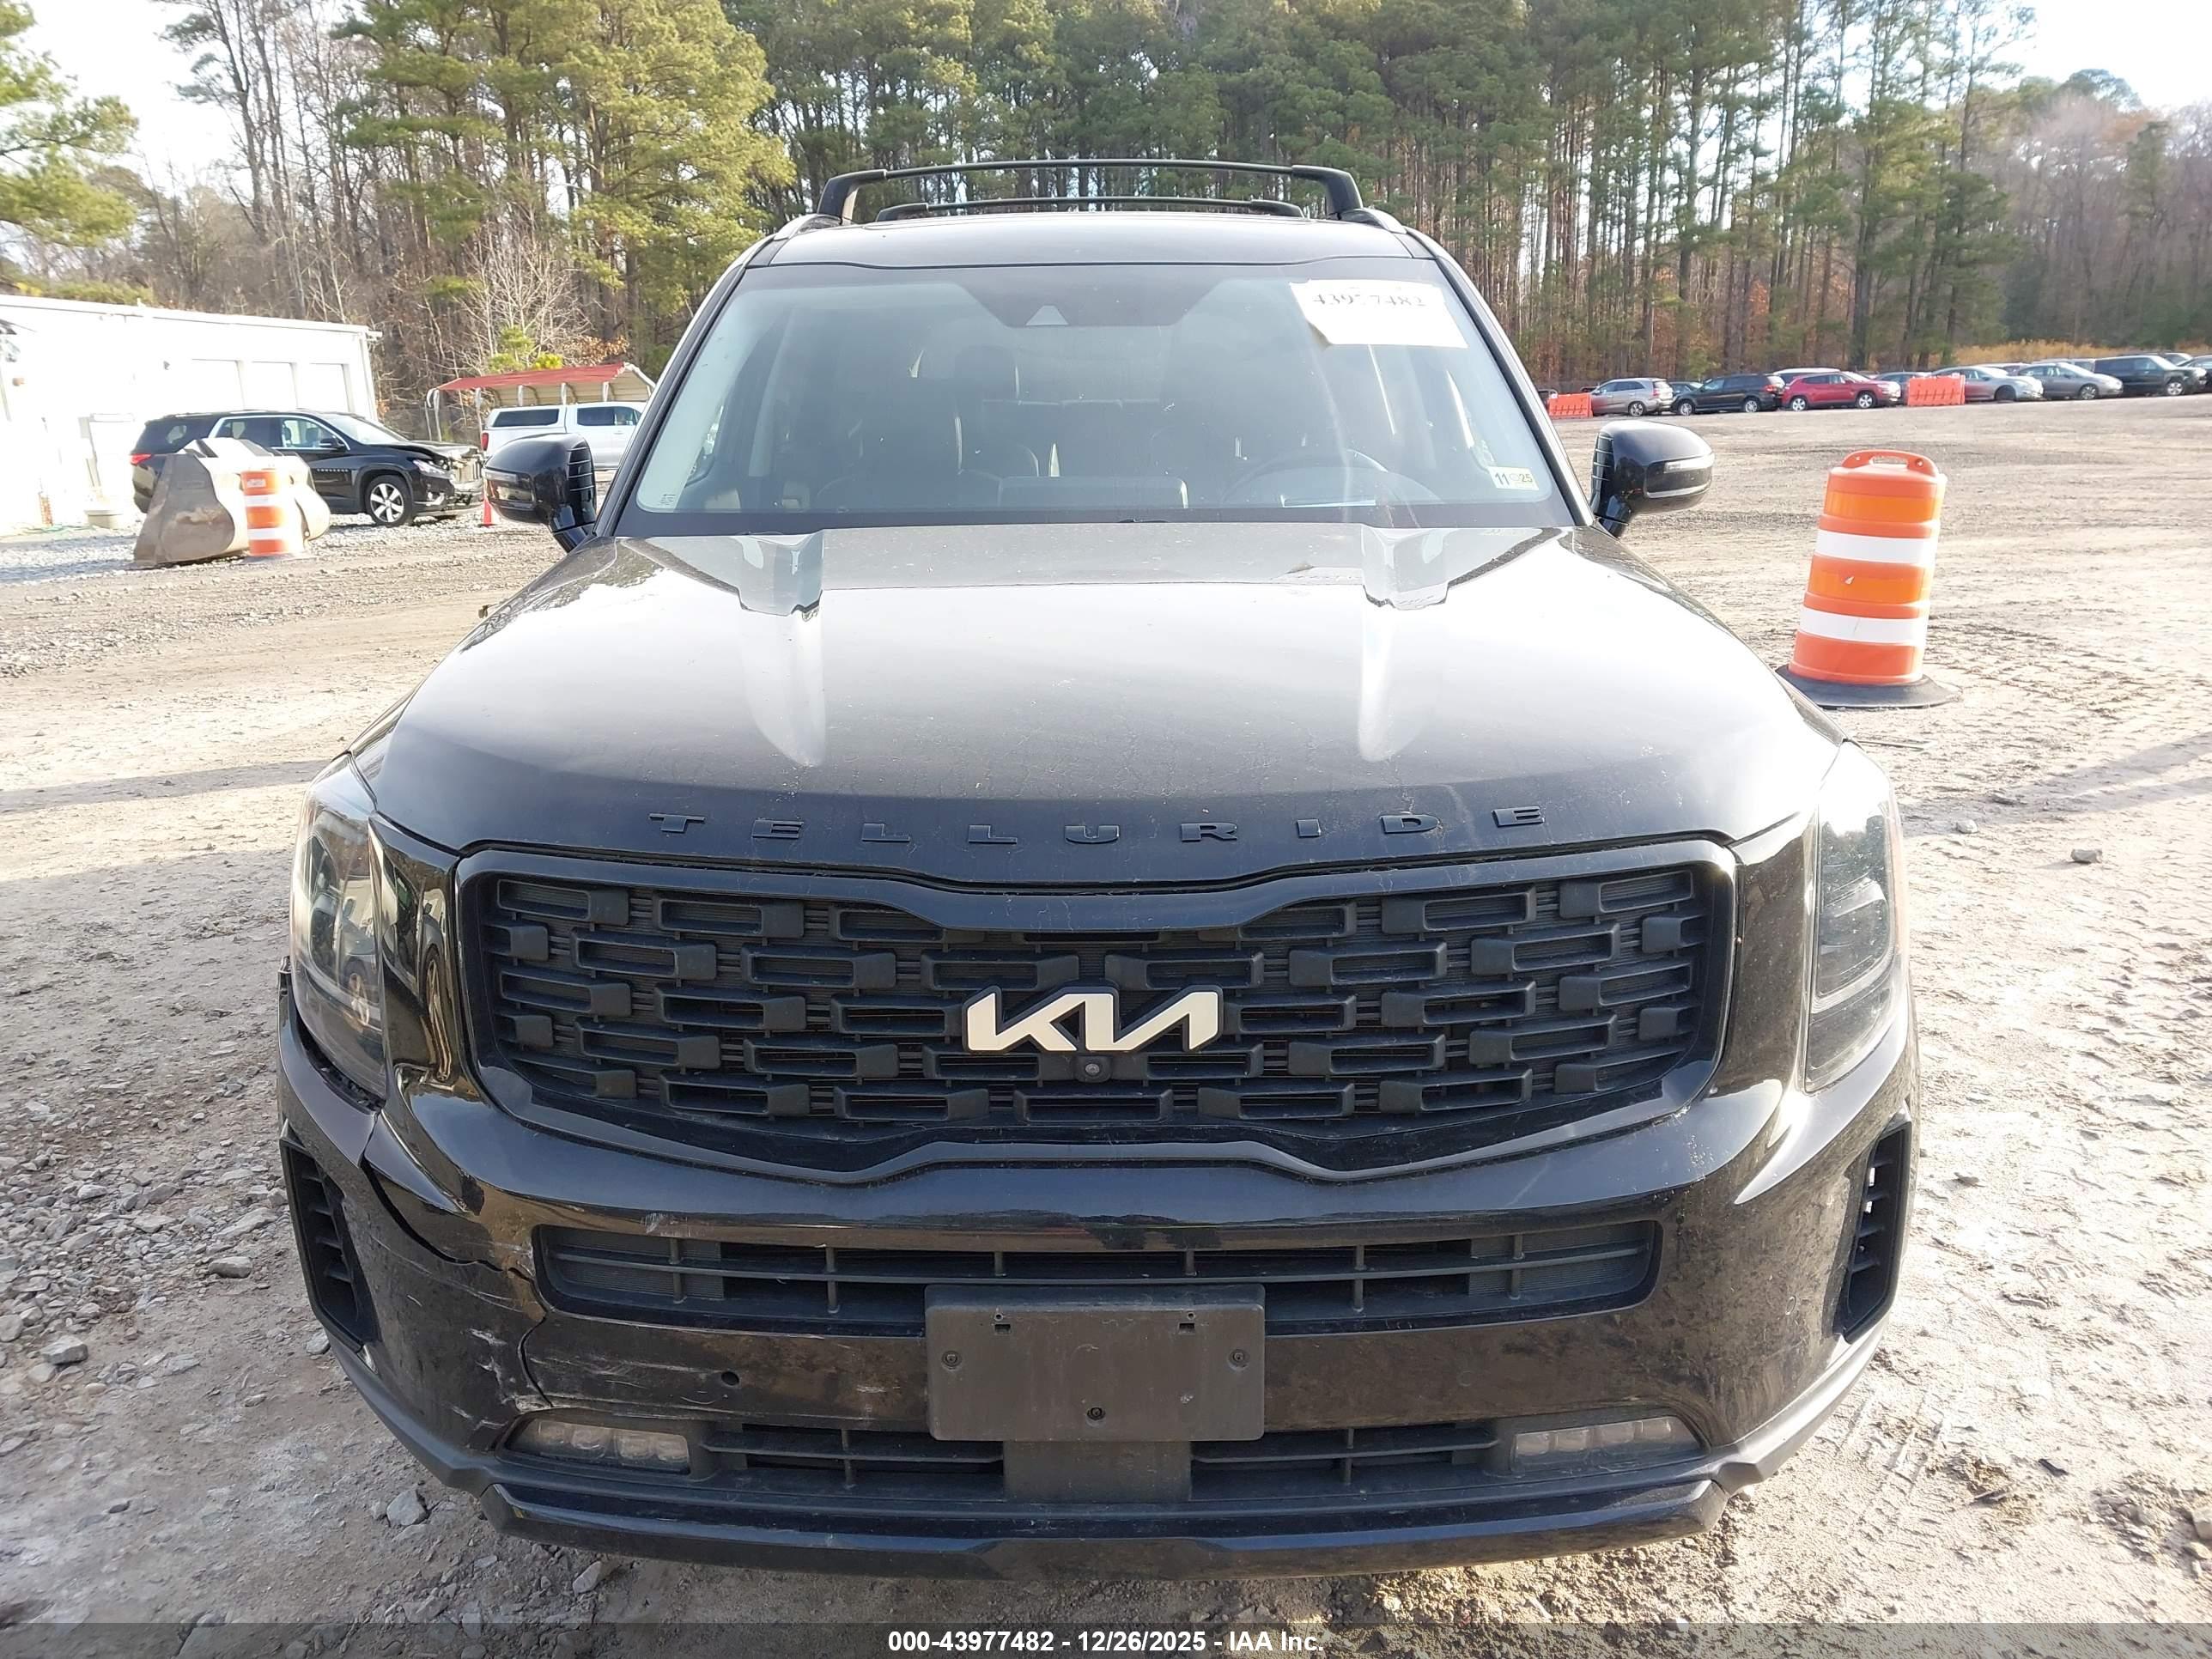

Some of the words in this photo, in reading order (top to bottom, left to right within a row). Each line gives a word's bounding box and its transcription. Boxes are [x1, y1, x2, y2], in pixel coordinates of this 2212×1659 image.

[1495, 472, 1510, 485] 11
[649, 805, 1545, 844] TELLURIDE
[967, 991, 1218, 1051] KIA
